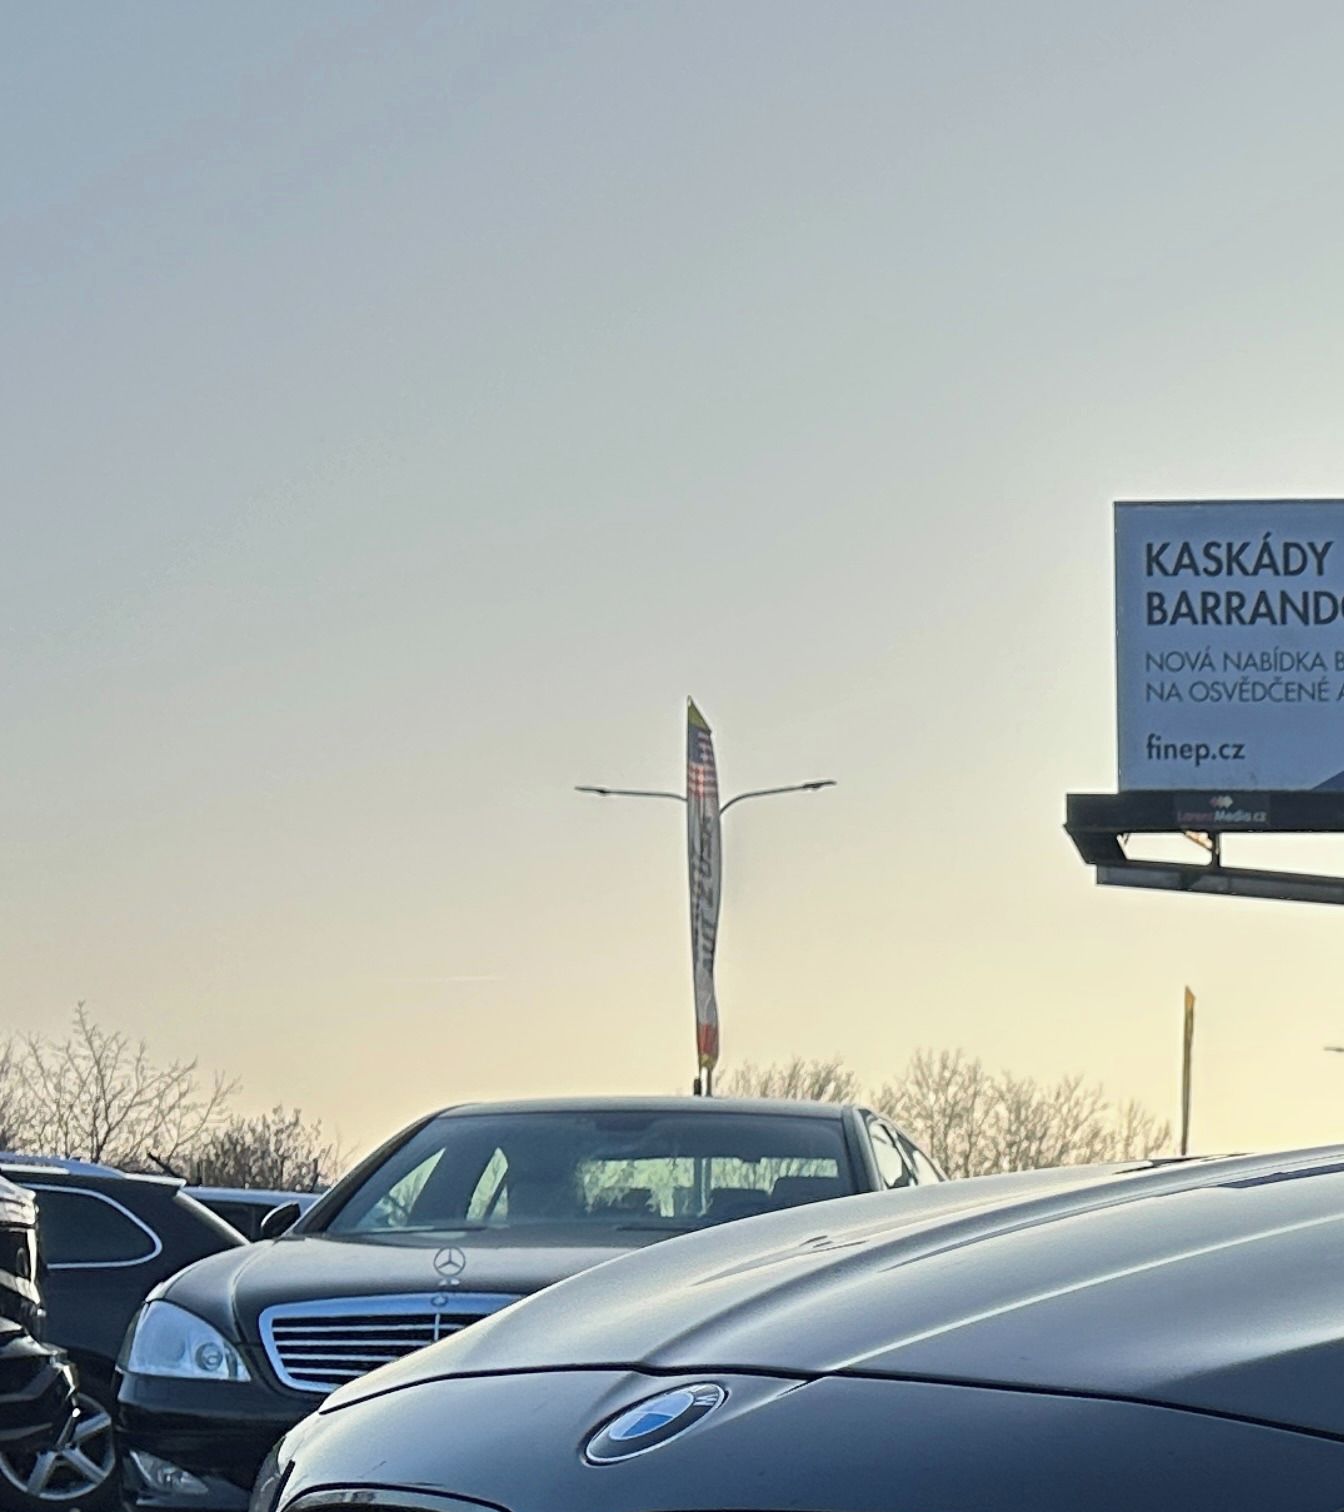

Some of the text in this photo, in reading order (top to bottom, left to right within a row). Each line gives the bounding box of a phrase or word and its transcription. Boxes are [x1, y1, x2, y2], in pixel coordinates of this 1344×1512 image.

[1146, 532, 1335, 577] KASKÁDY
[1146, 645, 1216, 672] NOVÁ
[1223, 646, 1328, 672] NABÍDKA
[1146, 682, 1183, 702] NA
[1189, 676, 1330, 702] OSVĚDČENÉ
[1147, 733, 1246, 767] finep.cz
